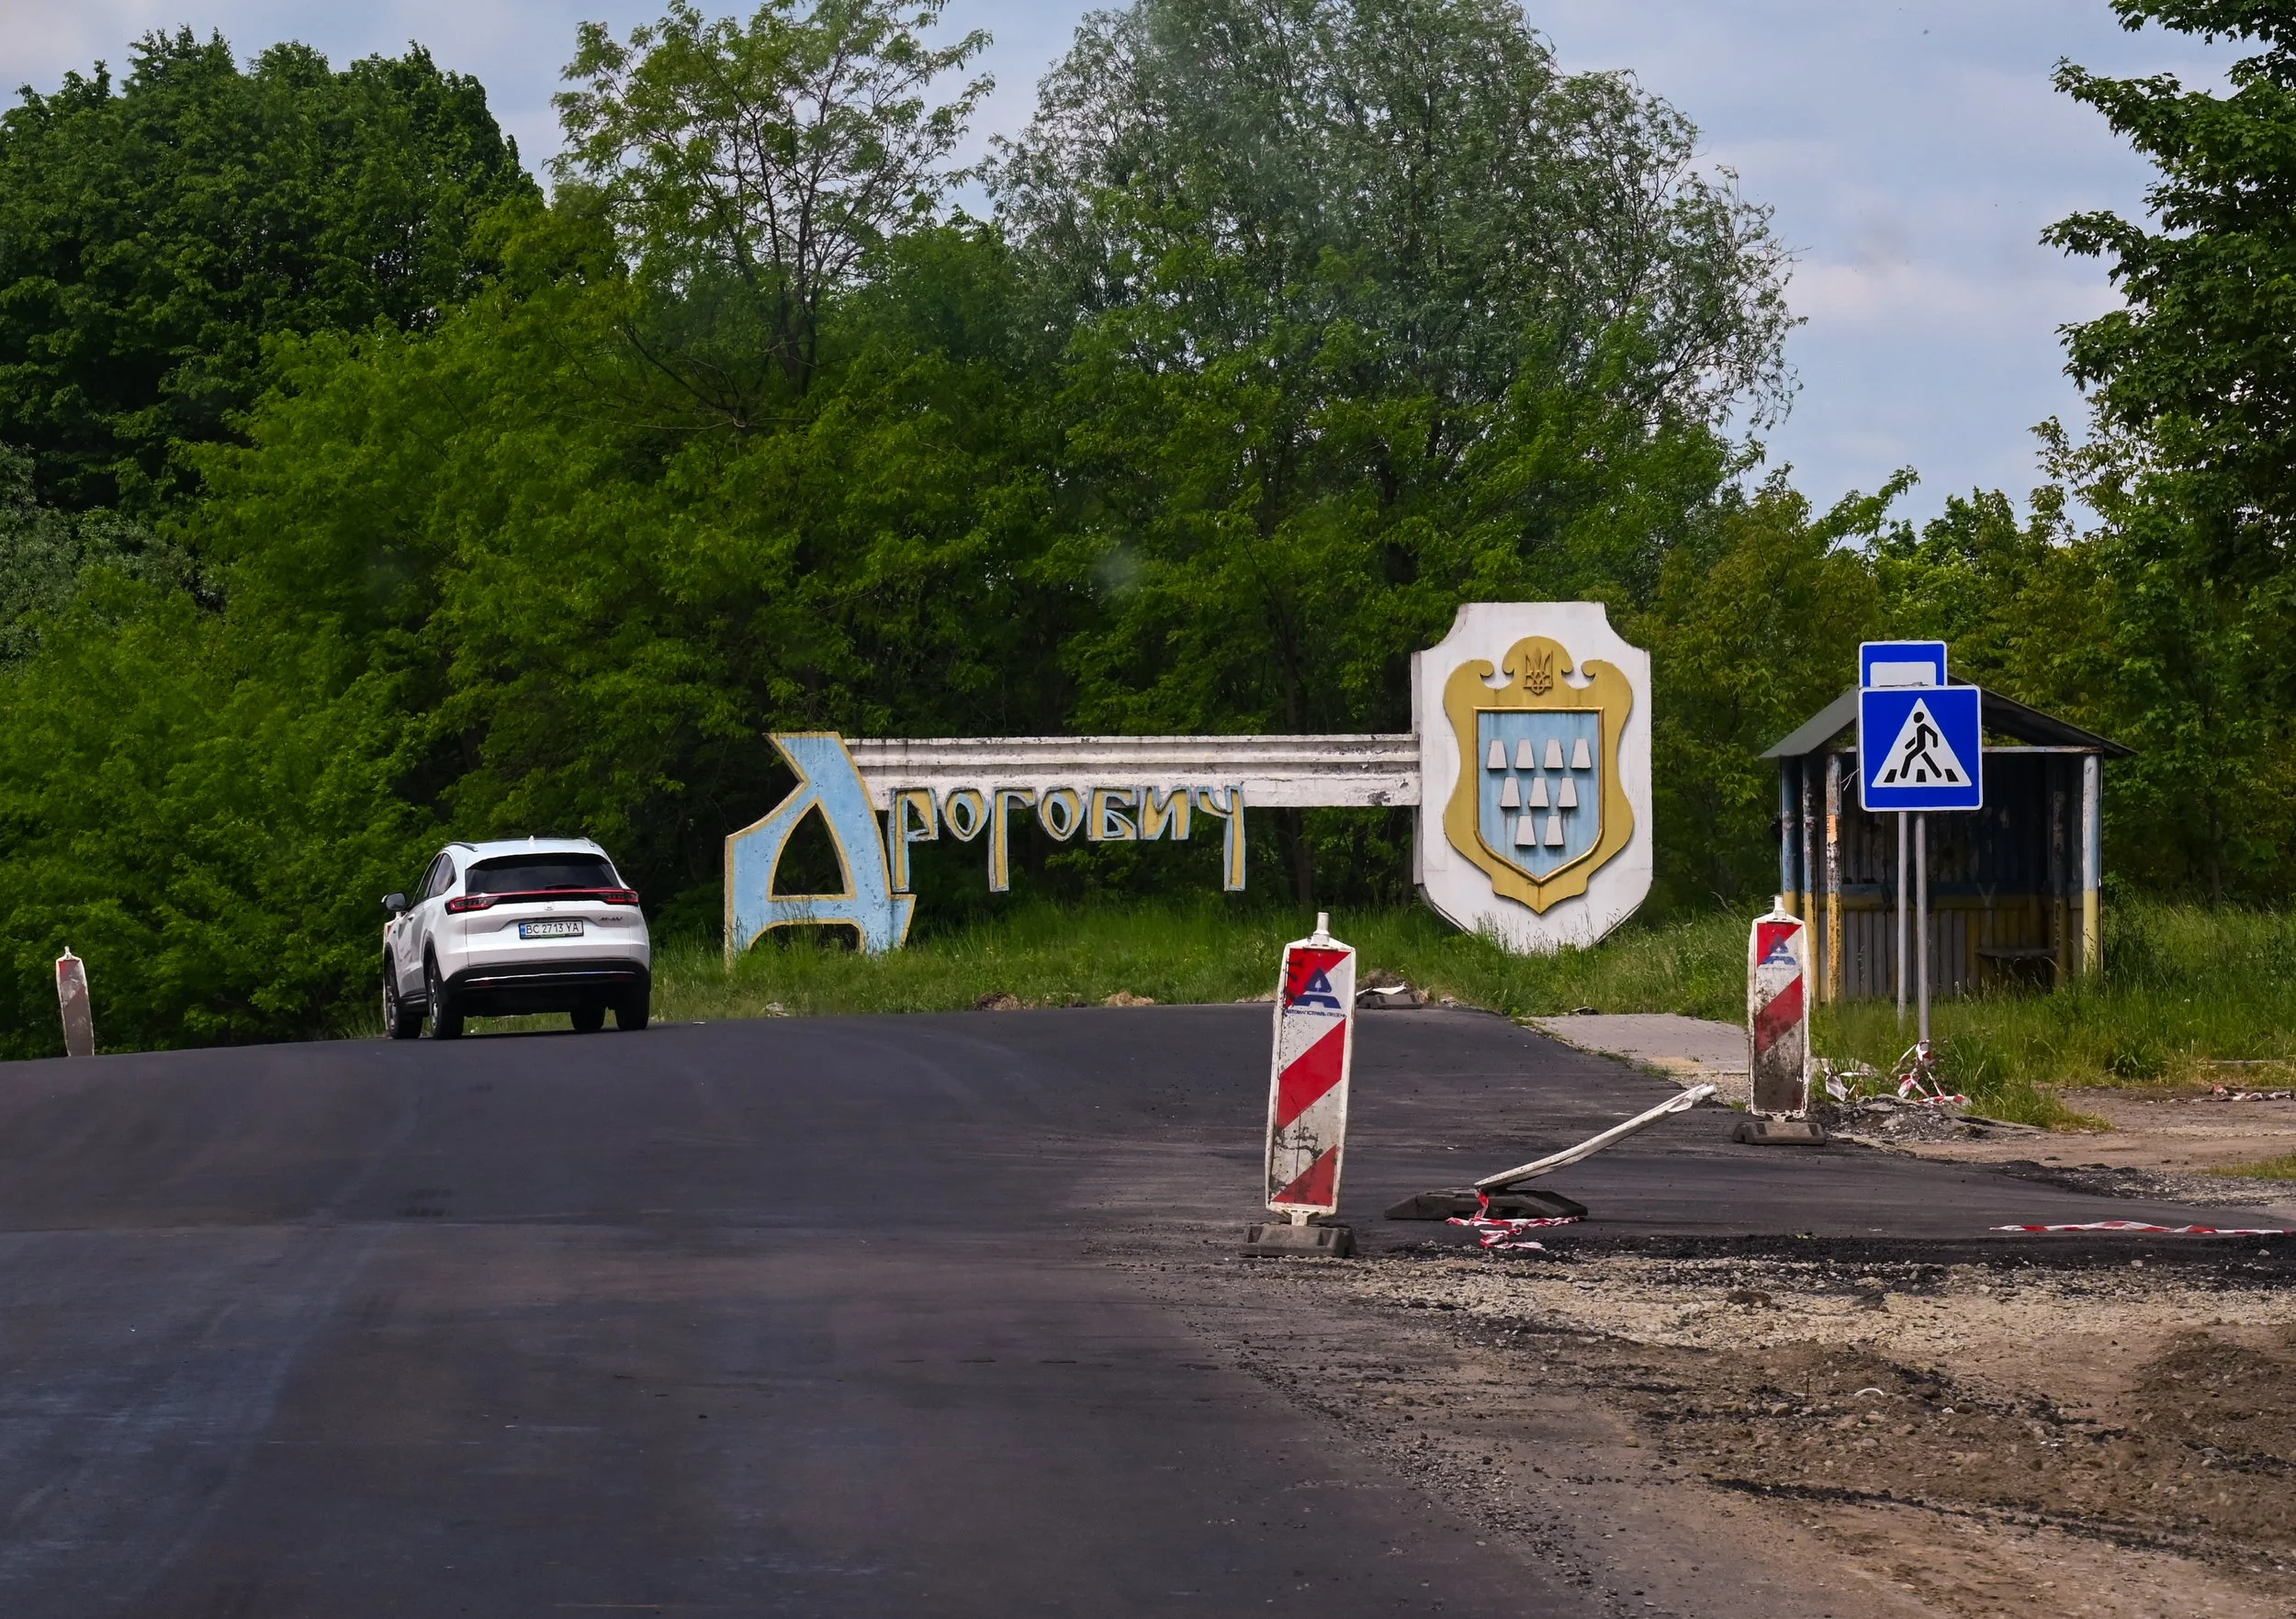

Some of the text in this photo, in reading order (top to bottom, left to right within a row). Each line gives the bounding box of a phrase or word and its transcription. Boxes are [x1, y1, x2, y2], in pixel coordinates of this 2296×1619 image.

[525, 922, 580, 935] BC 2713 YA
